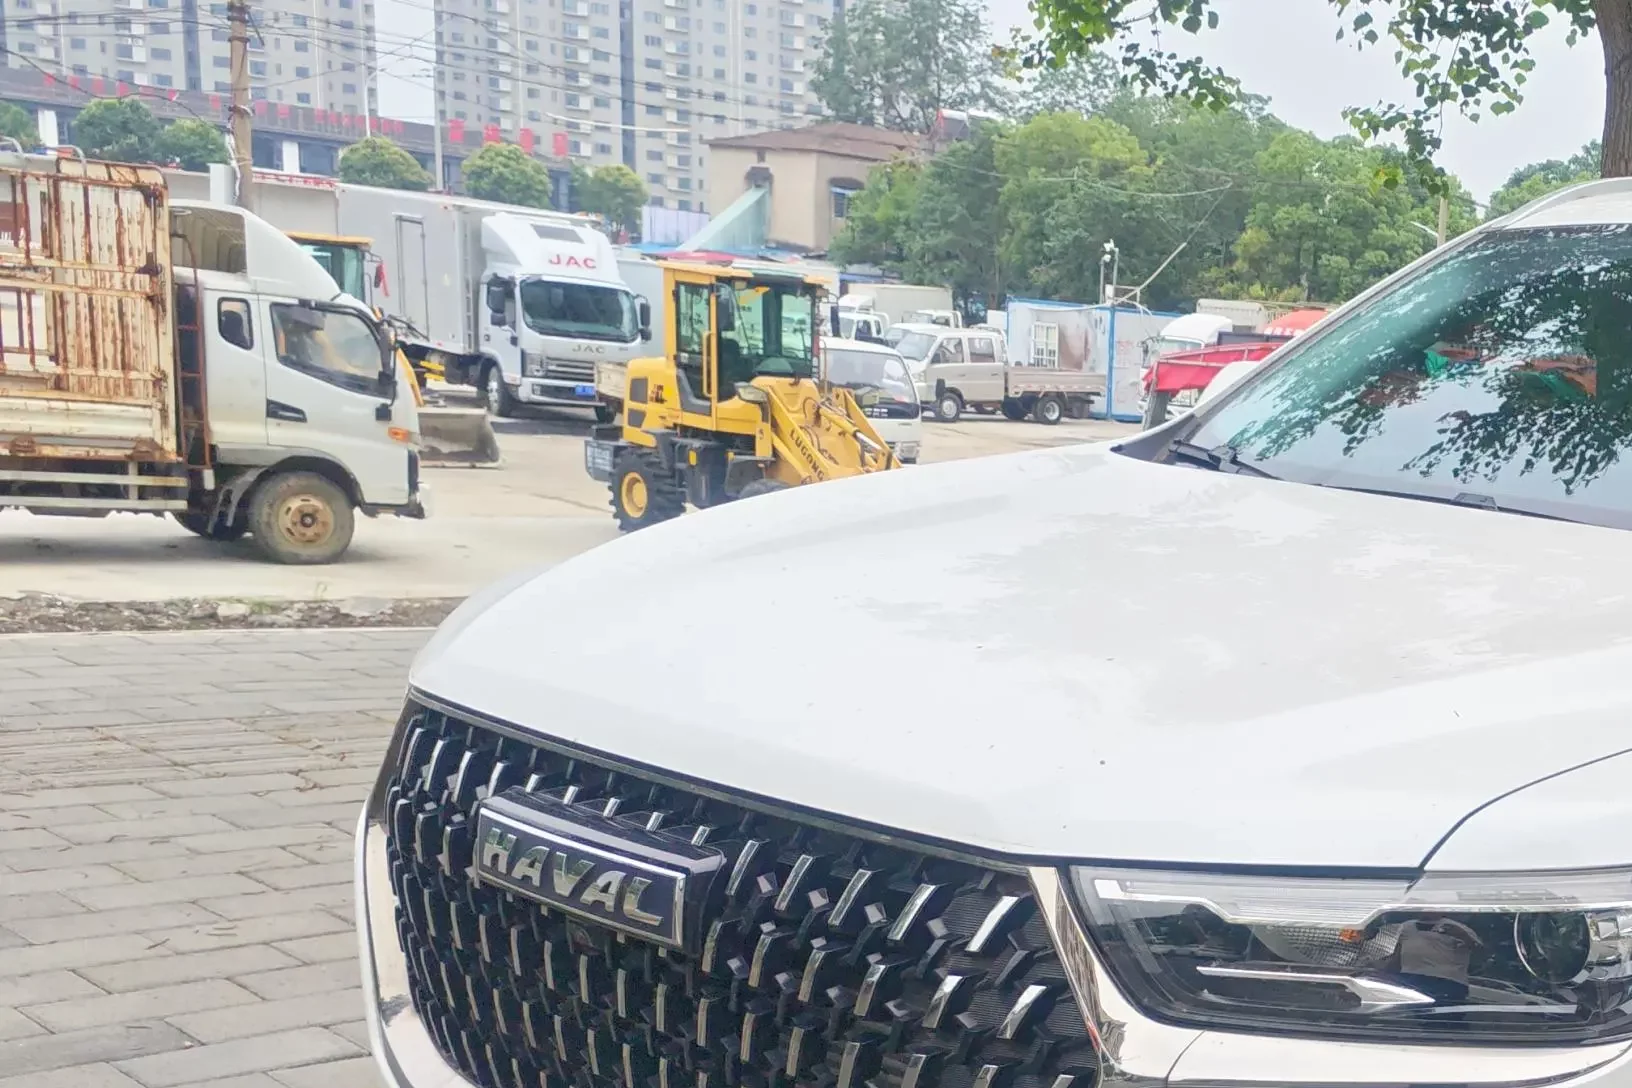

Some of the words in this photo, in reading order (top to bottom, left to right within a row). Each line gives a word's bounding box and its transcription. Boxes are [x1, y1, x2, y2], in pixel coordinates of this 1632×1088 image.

[548, 253, 597, 269] JAC
[572, 344, 605, 354] JAC
[790, 429, 825, 480] LUGONG
[483, 827, 665, 927] HAVAL
